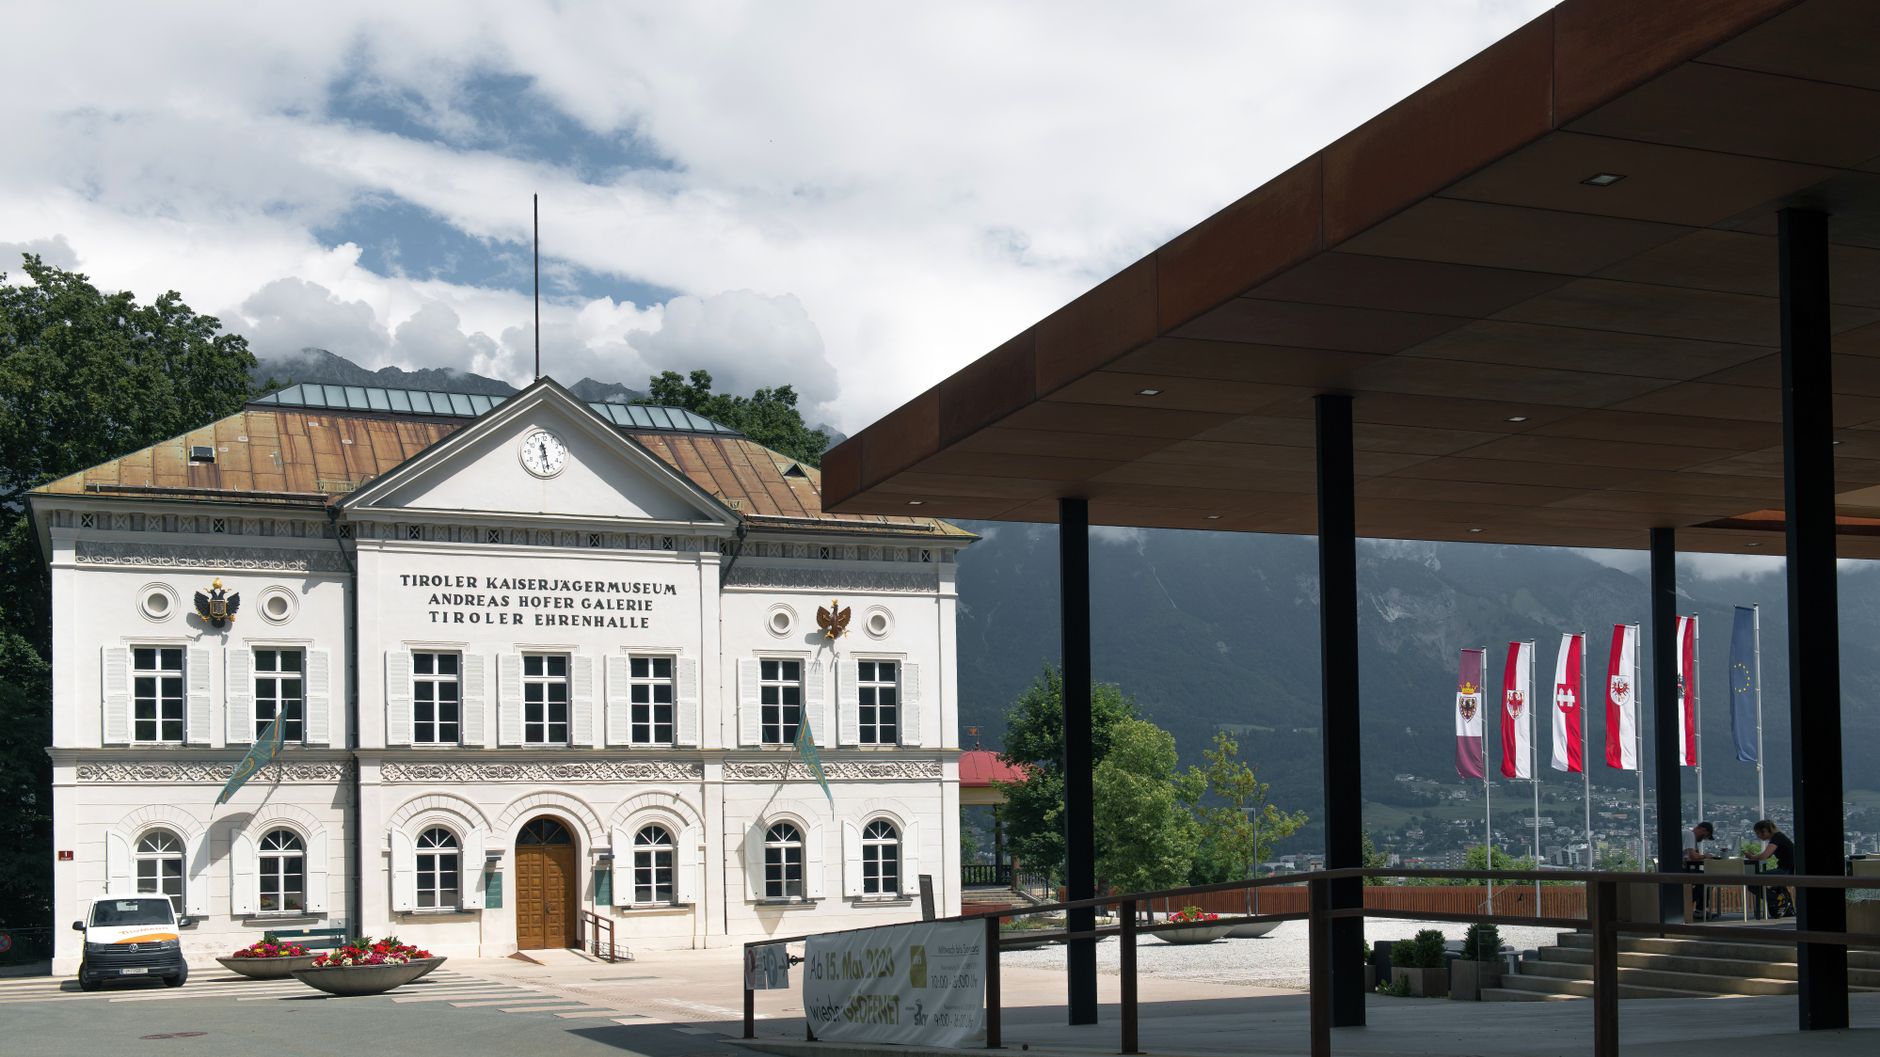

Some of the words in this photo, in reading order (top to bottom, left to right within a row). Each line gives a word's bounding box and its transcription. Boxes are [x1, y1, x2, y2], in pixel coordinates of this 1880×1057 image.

[399, 574, 478, 589] TIROLER
[486, 576, 677, 596] KAISERJÄGERMUSEUM
[428, 593, 510, 608] ANDREAS
[518, 595, 575, 609] HOFER
[581, 597, 653, 612] GALERIE
[428, 610, 525, 625] TIROLER
[534, 613, 649, 629] EHRENHALLE
[810, 950, 823, 980] Ab
[825, 951, 840, 981] 15.
[842, 949, 865, 980] Mai
